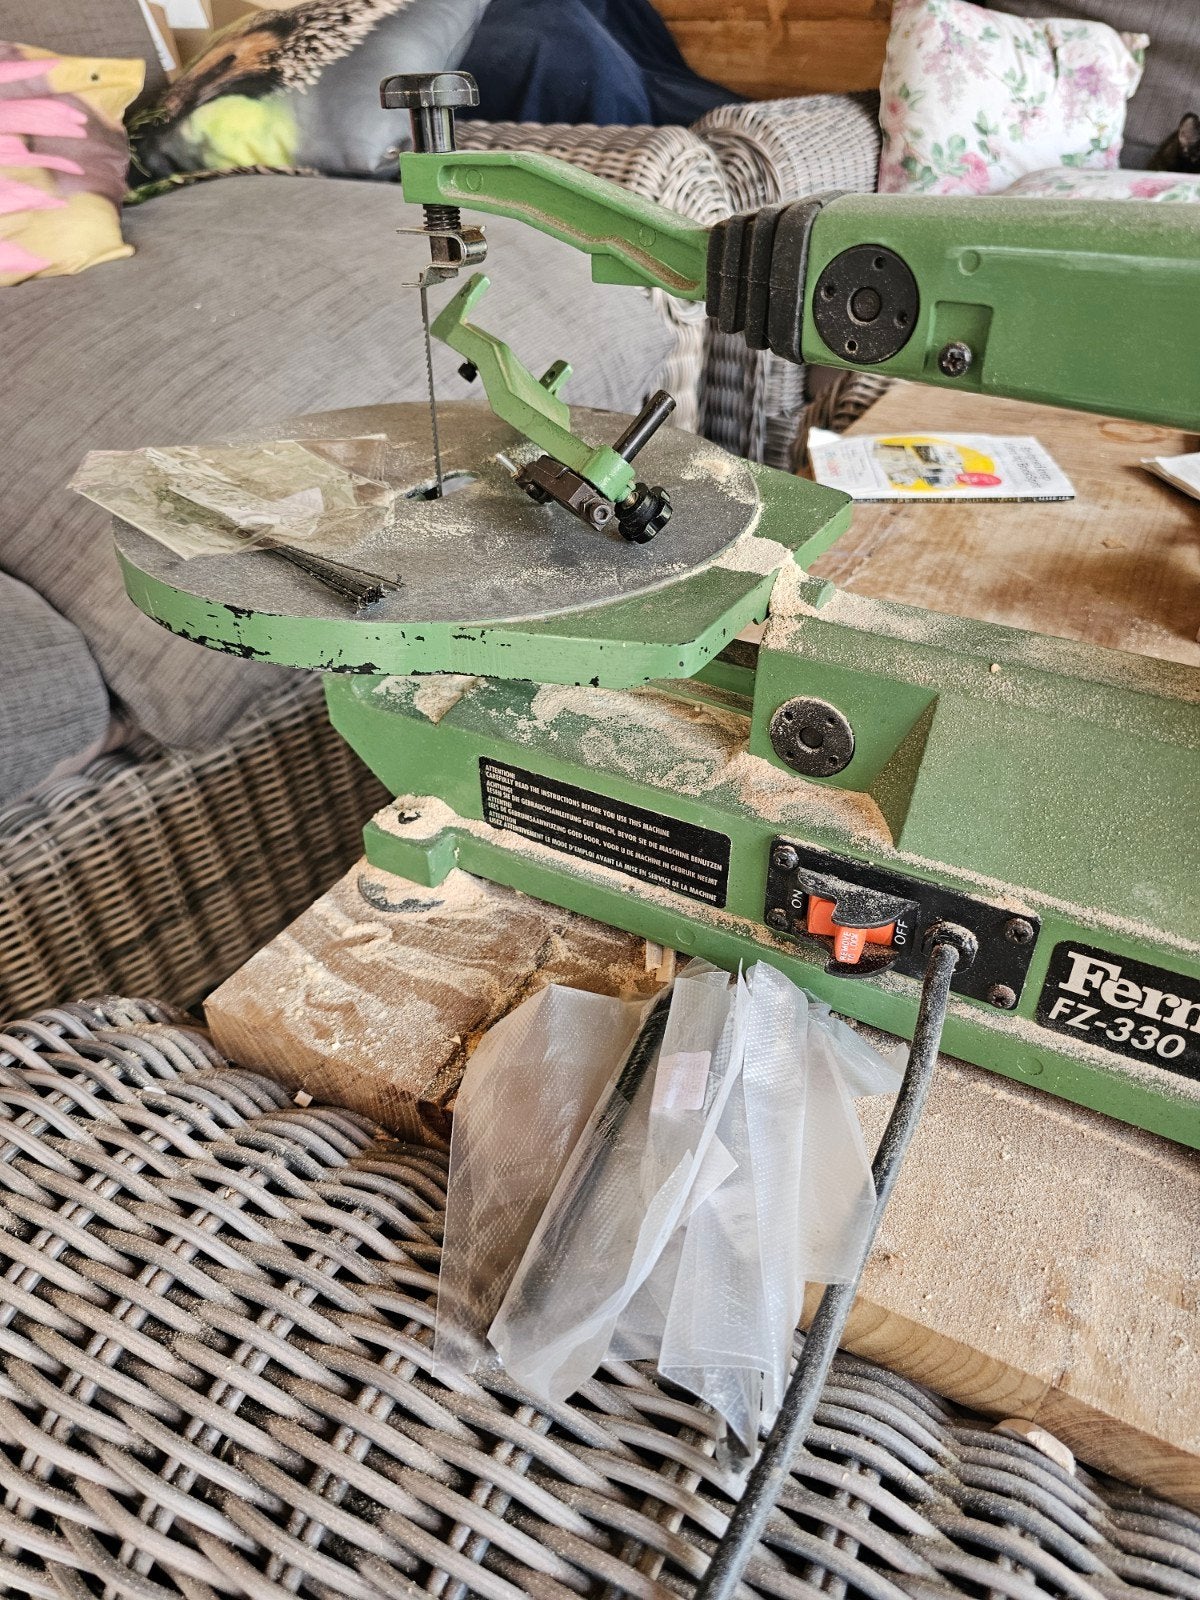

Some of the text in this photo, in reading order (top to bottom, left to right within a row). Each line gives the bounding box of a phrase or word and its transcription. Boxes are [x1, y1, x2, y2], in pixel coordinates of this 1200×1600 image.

[485, 771, 671, 838] CAREFULLY READ THE INSTRUCTIONS BEFORE YOU USE THIS MACHINE
[486, 786, 503, 798] LESEN
[502, 791, 511, 800] SIE
[511, 794, 520, 803] DIE
[520, 797, 582, 824] GEBRAUCHSANLEITUNG
[582, 818, 595, 828] GUT
[617, 830, 637, 843] BEVOR
[638, 837, 648, 846] SIE
[648, 840, 658, 850] DIE
[659, 844, 690, 860] MASCHINE
[690, 855, 723, 872] BENUTZEN
[500, 805, 507, 813] DE
[567, 829, 583, 839] GOED
[602, 841, 620, 852] VOOR
[620, 846, 626, 854] U
[626, 849, 634, 857] DE
[634, 852, 662, 867] MACHINE
[662, 861, 670, 869] IN
[670, 864, 696, 879] GEBRUIK
[697, 874, 719, 886] NEEMT
[503, 821, 544, 840] ATTENTIVEMENT
[544, 835, 551, 843] LE
[551, 838, 568, 849] MODE
[568, 843, 595, 858] D'EMPLOI
[595, 853, 615, 866] AVANT
[615, 860, 624, 869] LA
[623, 863, 639, 875] MISE
[639, 868, 647, 877] EN
[648, 871, 671, 885] SERVICE
[671, 880, 680, 888] DE
[680, 882, 689, 891] LA
[689, 886, 717, 902] MACHINE
[791, 889, 803, 909] ON
[894, 918, 909, 945] OFF
[839, 931, 851, 962] REMOVE
[1048, 996, 1187, 1059] FZ-330
